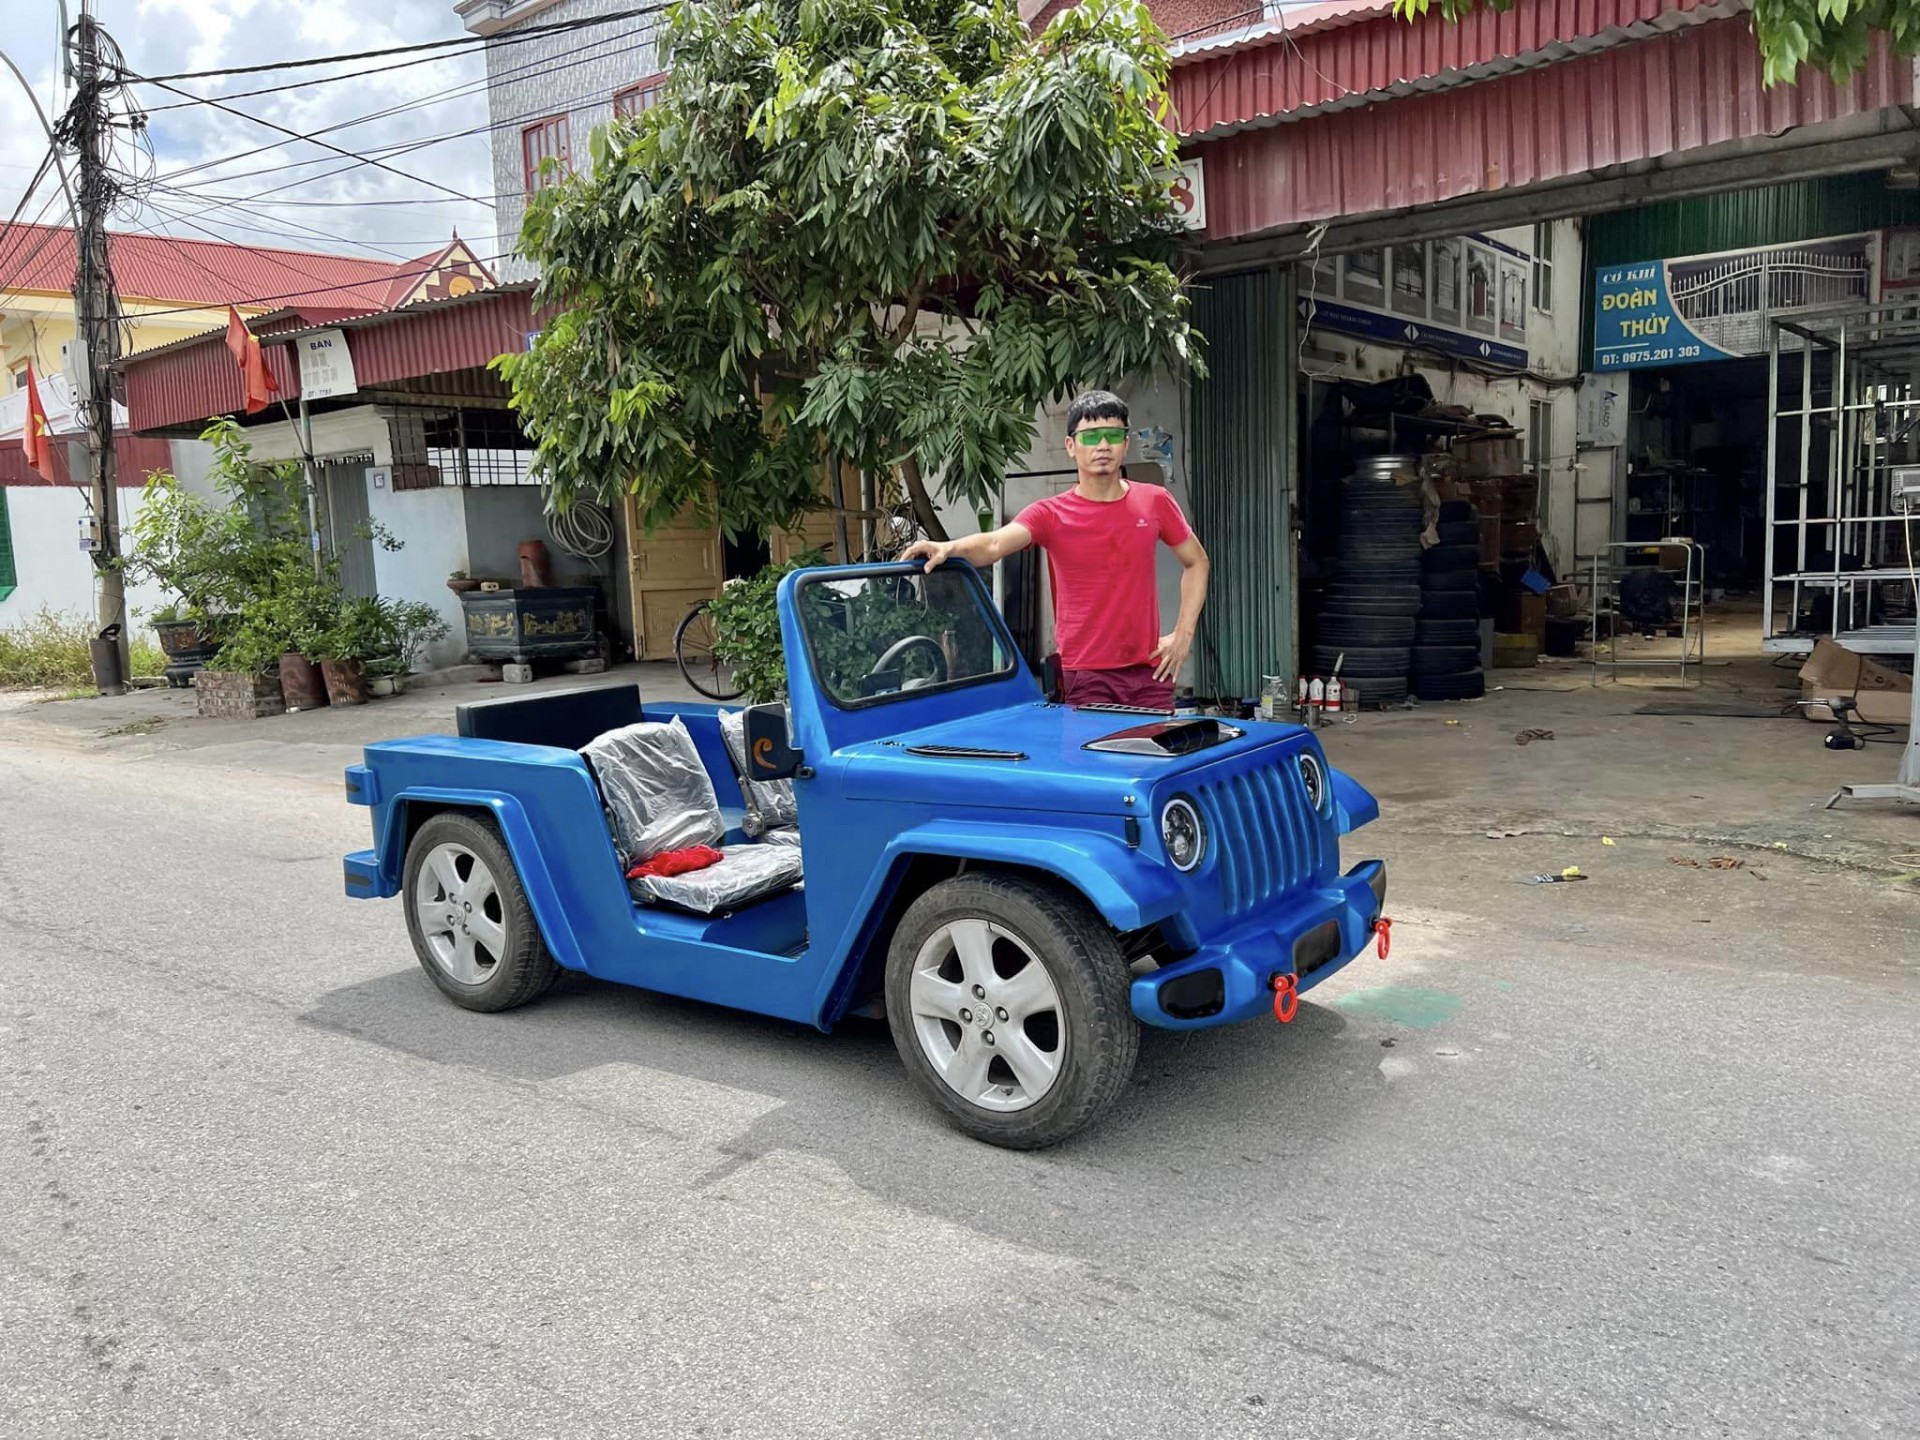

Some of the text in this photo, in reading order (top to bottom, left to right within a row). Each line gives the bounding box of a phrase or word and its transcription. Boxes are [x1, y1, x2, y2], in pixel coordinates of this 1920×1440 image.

[1602, 287, 1657, 311] ĐOÀN
[1620, 312, 1670, 337] THỦY
[1622, 349, 1674, 363] 0975.201
[1678, 345, 1700, 358] 303
